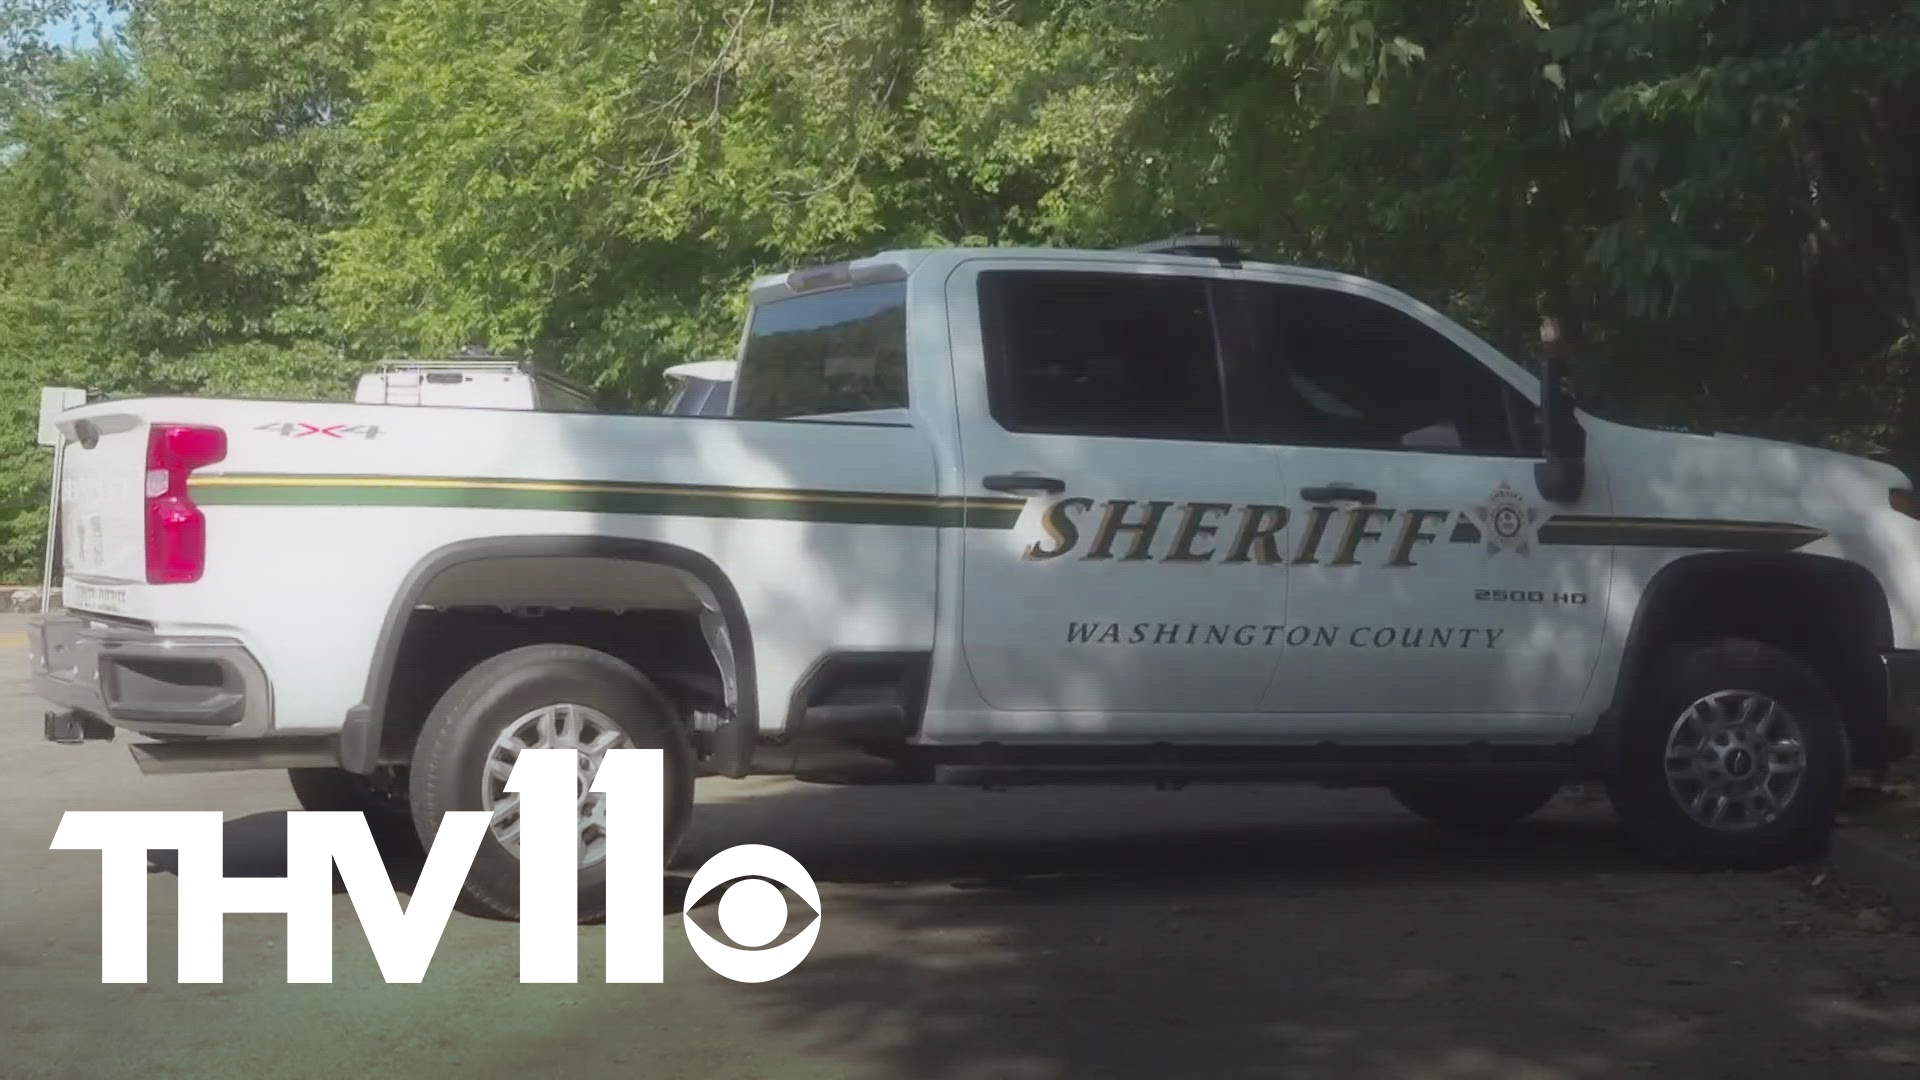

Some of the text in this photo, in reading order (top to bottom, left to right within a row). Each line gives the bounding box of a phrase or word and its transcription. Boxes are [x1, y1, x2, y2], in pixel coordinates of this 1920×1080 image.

[1022, 496, 1453, 568] SHERIFF
[1474, 589, 1587, 604] 2500 HD
[1066, 621, 1505, 649] WASHINGTON COUNTY
